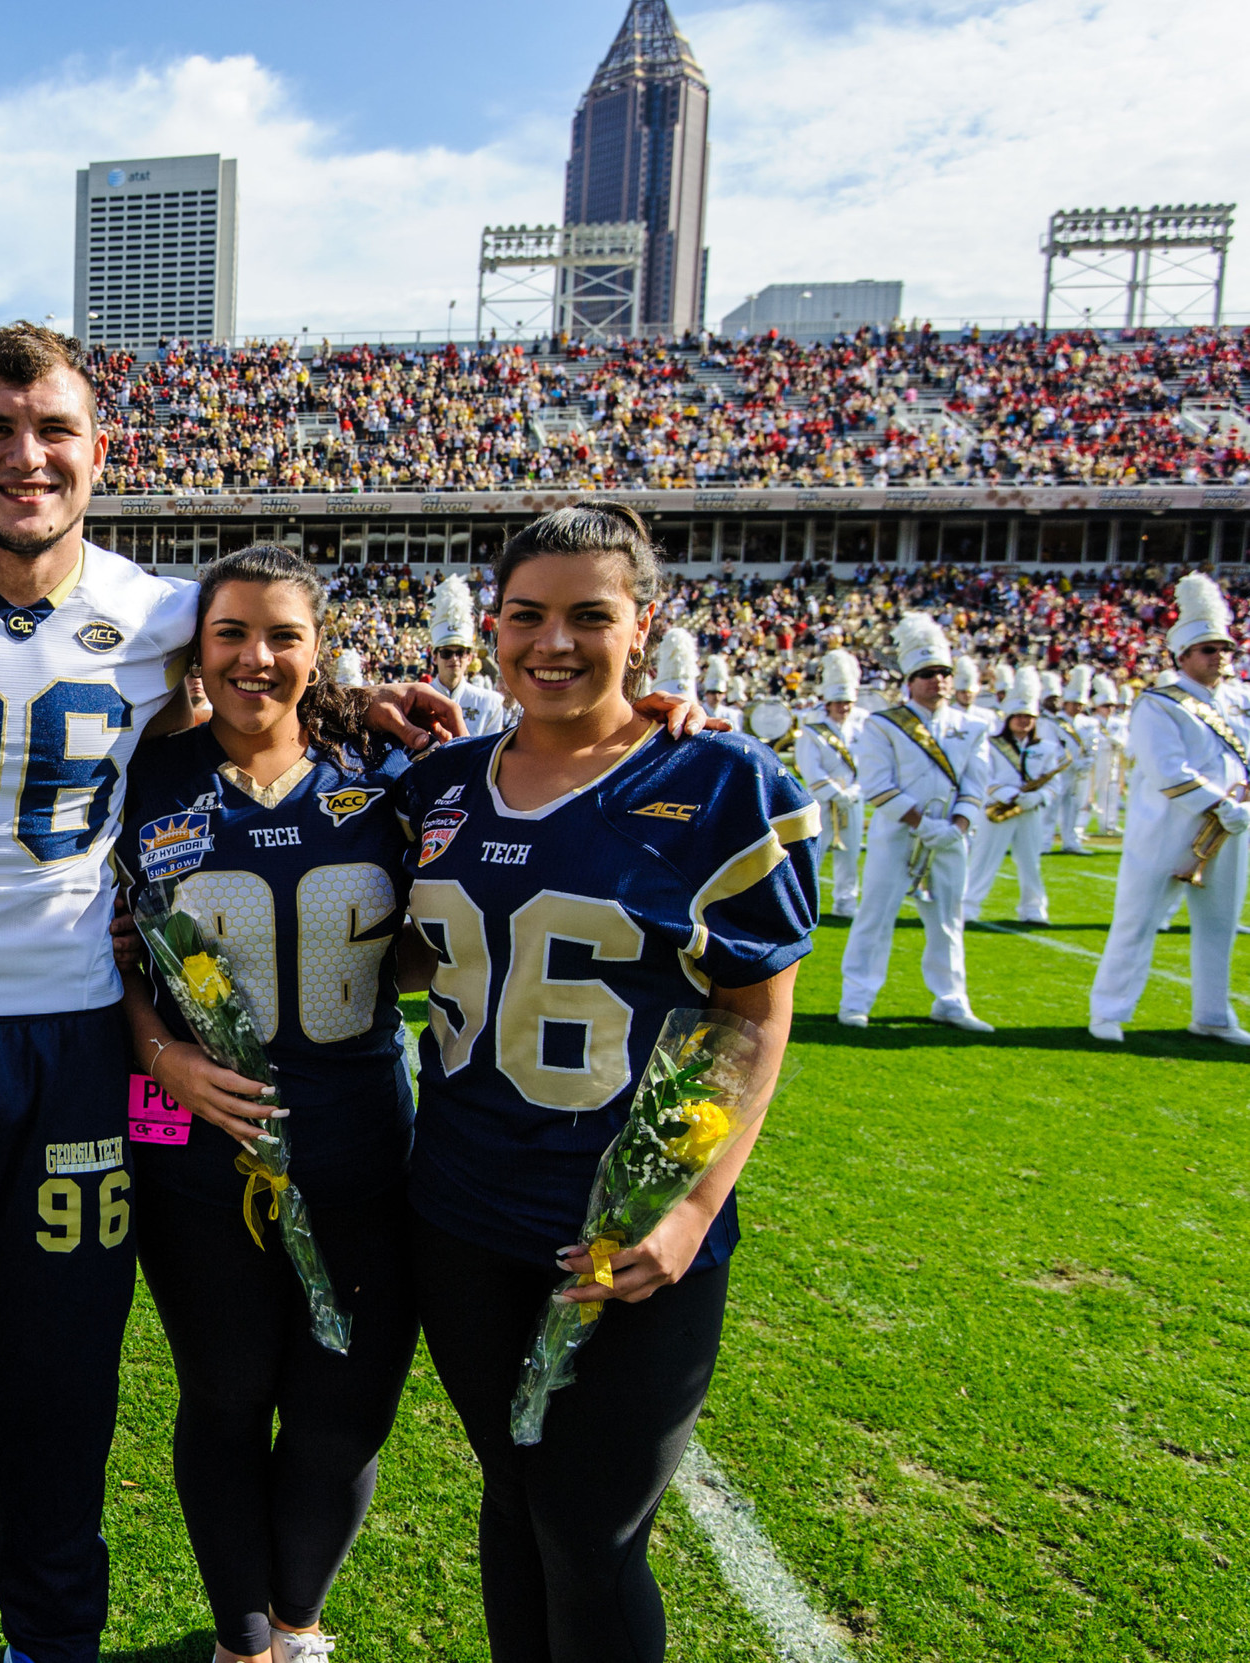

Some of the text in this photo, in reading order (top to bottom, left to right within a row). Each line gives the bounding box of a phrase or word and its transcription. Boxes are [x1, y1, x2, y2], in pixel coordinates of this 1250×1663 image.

[121, 505, 162, 515] DAVIS
[175, 504, 243, 515] HAMILTON
[261, 504, 301, 514] PUND
[326, 503, 391, 513] FLOWERS
[421, 502, 472, 512] GUYON
[9, 616, 34, 633] GT
[83, 628, 118, 642] ACC
[193, 791, 216, 806] R
[331, 795, 363, 809] ACC
[641, 802, 699, 818] ACC
[249, 826, 302, 848] TECH
[159, 840, 203, 858] HYUNDAI
[481, 841, 532, 865] TECH
[150, 858, 199, 878] SUN BOWL
[172, 862, 396, 1045] 96
[406, 878, 645, 1111] 96
[143, 1080, 179, 1112] PG
[163, 1127, 177, 1136] G
[46, 1136, 123, 1174] GEORGIA TECH
[36, 1170, 131, 1253] 96
